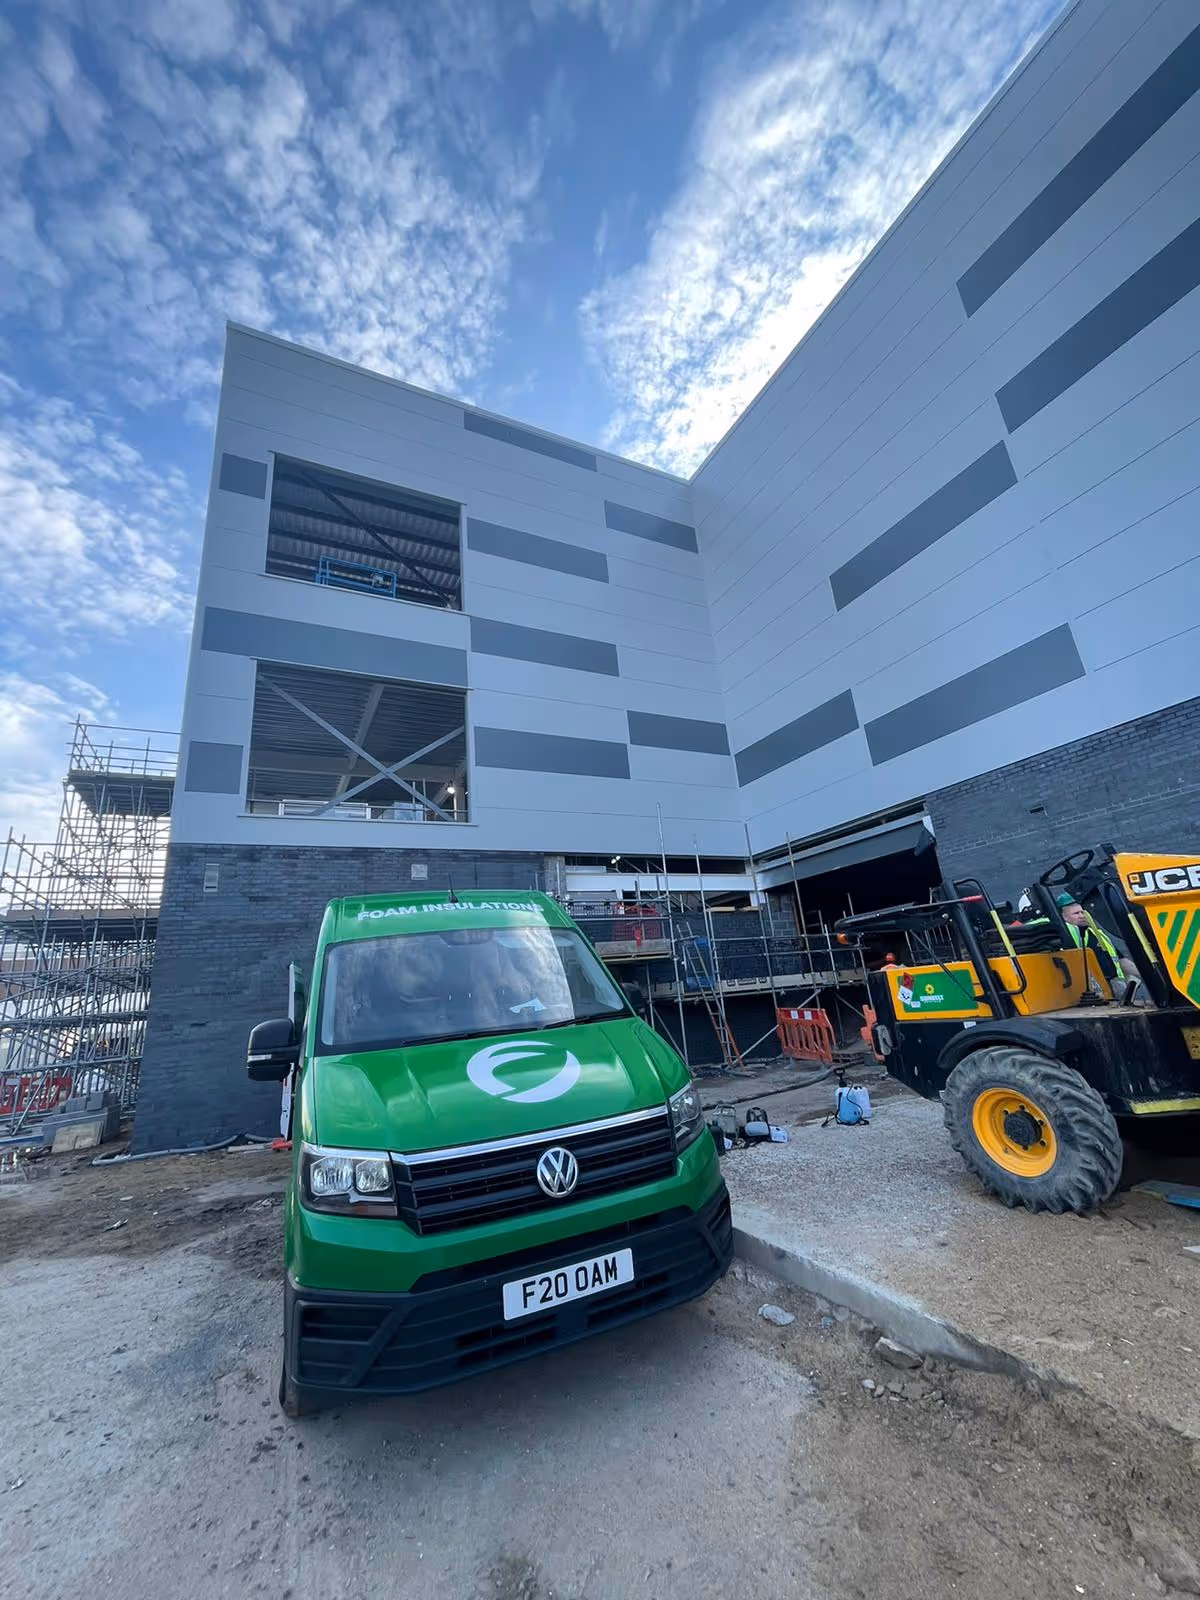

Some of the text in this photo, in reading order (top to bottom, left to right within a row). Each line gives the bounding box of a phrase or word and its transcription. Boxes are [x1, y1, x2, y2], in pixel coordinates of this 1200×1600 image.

[357, 905, 418, 921] FOAM
[537, 1147, 579, 1197] VW
[521, 1256, 618, 1309] F20 OAM
